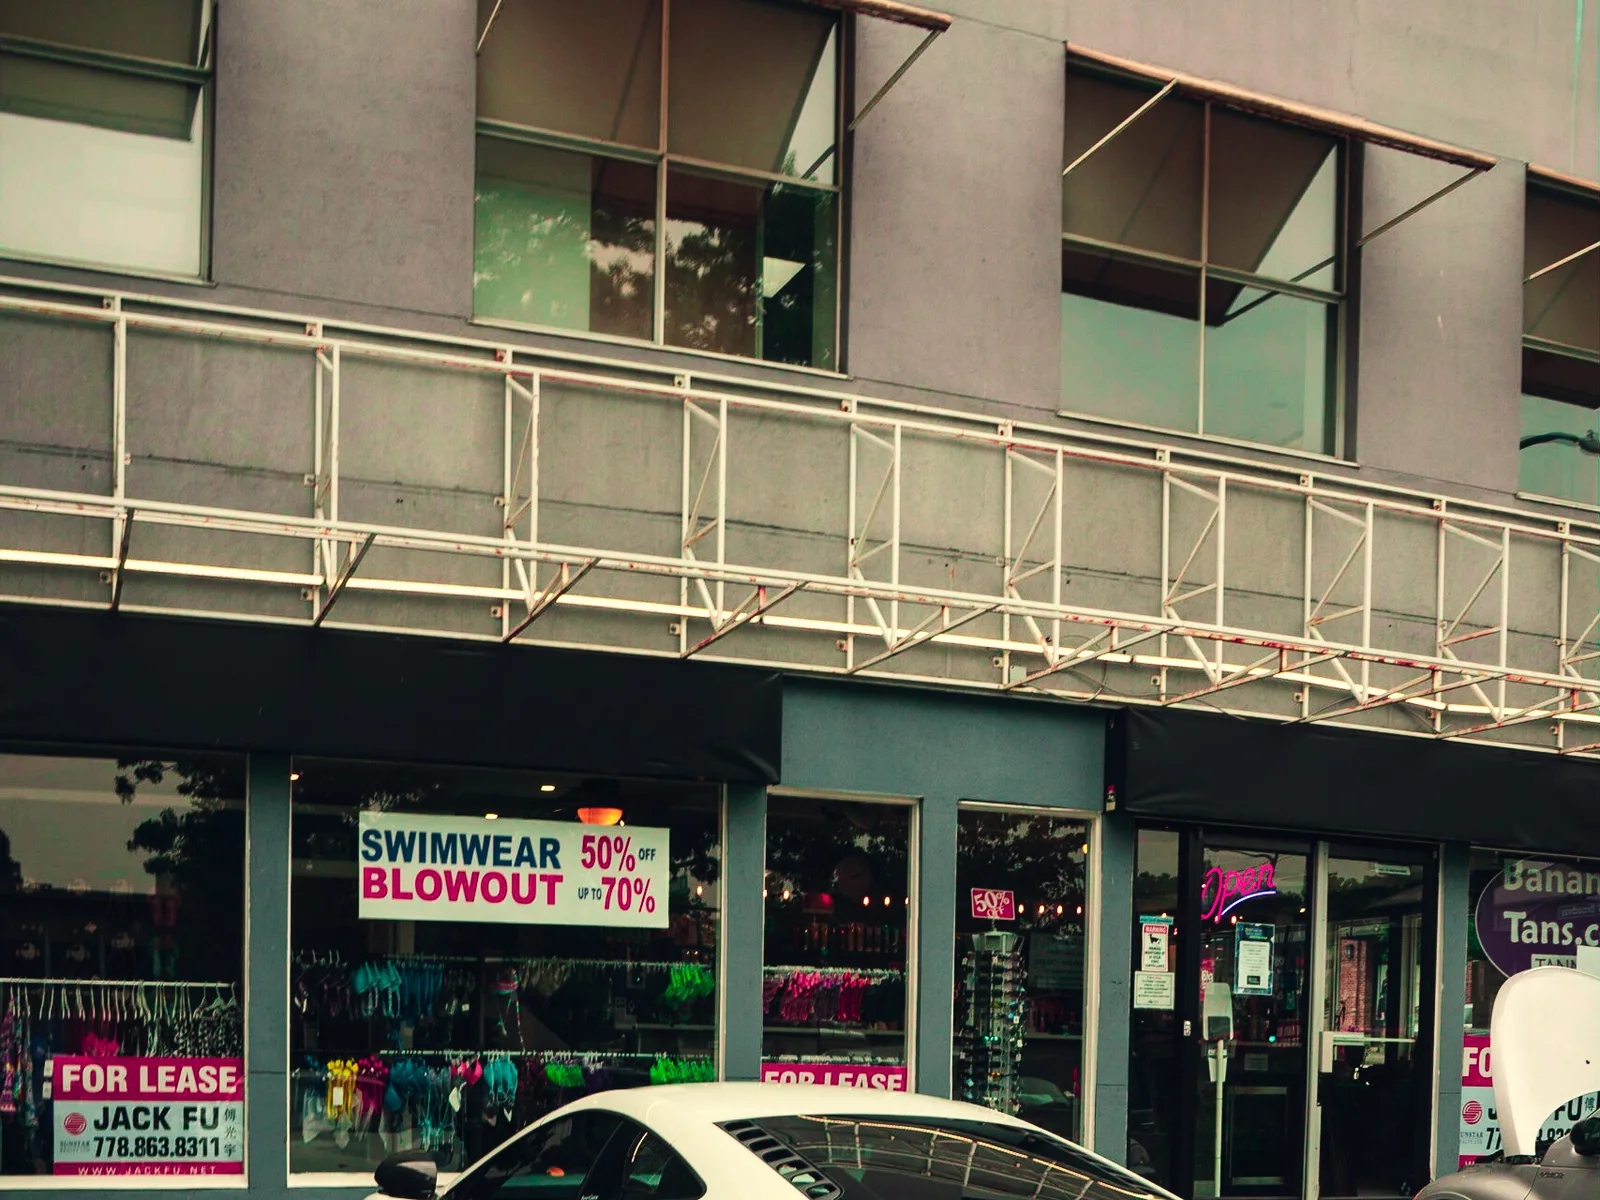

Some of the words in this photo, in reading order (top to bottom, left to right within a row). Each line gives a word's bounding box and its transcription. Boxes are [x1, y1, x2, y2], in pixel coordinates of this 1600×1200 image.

[361, 828, 561, 869] SWIMWEAR
[581, 835, 636, 872] 50%
[638, 847, 656, 861] OFF
[363, 867, 563, 905] BLOWOUT
[578, 887, 589, 900] UP
[591, 888, 602, 900] TO
[601, 876, 656, 913] 70%
[973, 890, 1010, 913] 50%
[1200, 863, 1275, 922] Open
[62, 1064, 128, 1093] FOR
[139, 1065, 238, 1094] LEASE
[93, 1106, 172, 1132] JACK
[182, 1106, 220, 1131] FU
[93, 1136, 220, 1158] 778.863.8311
